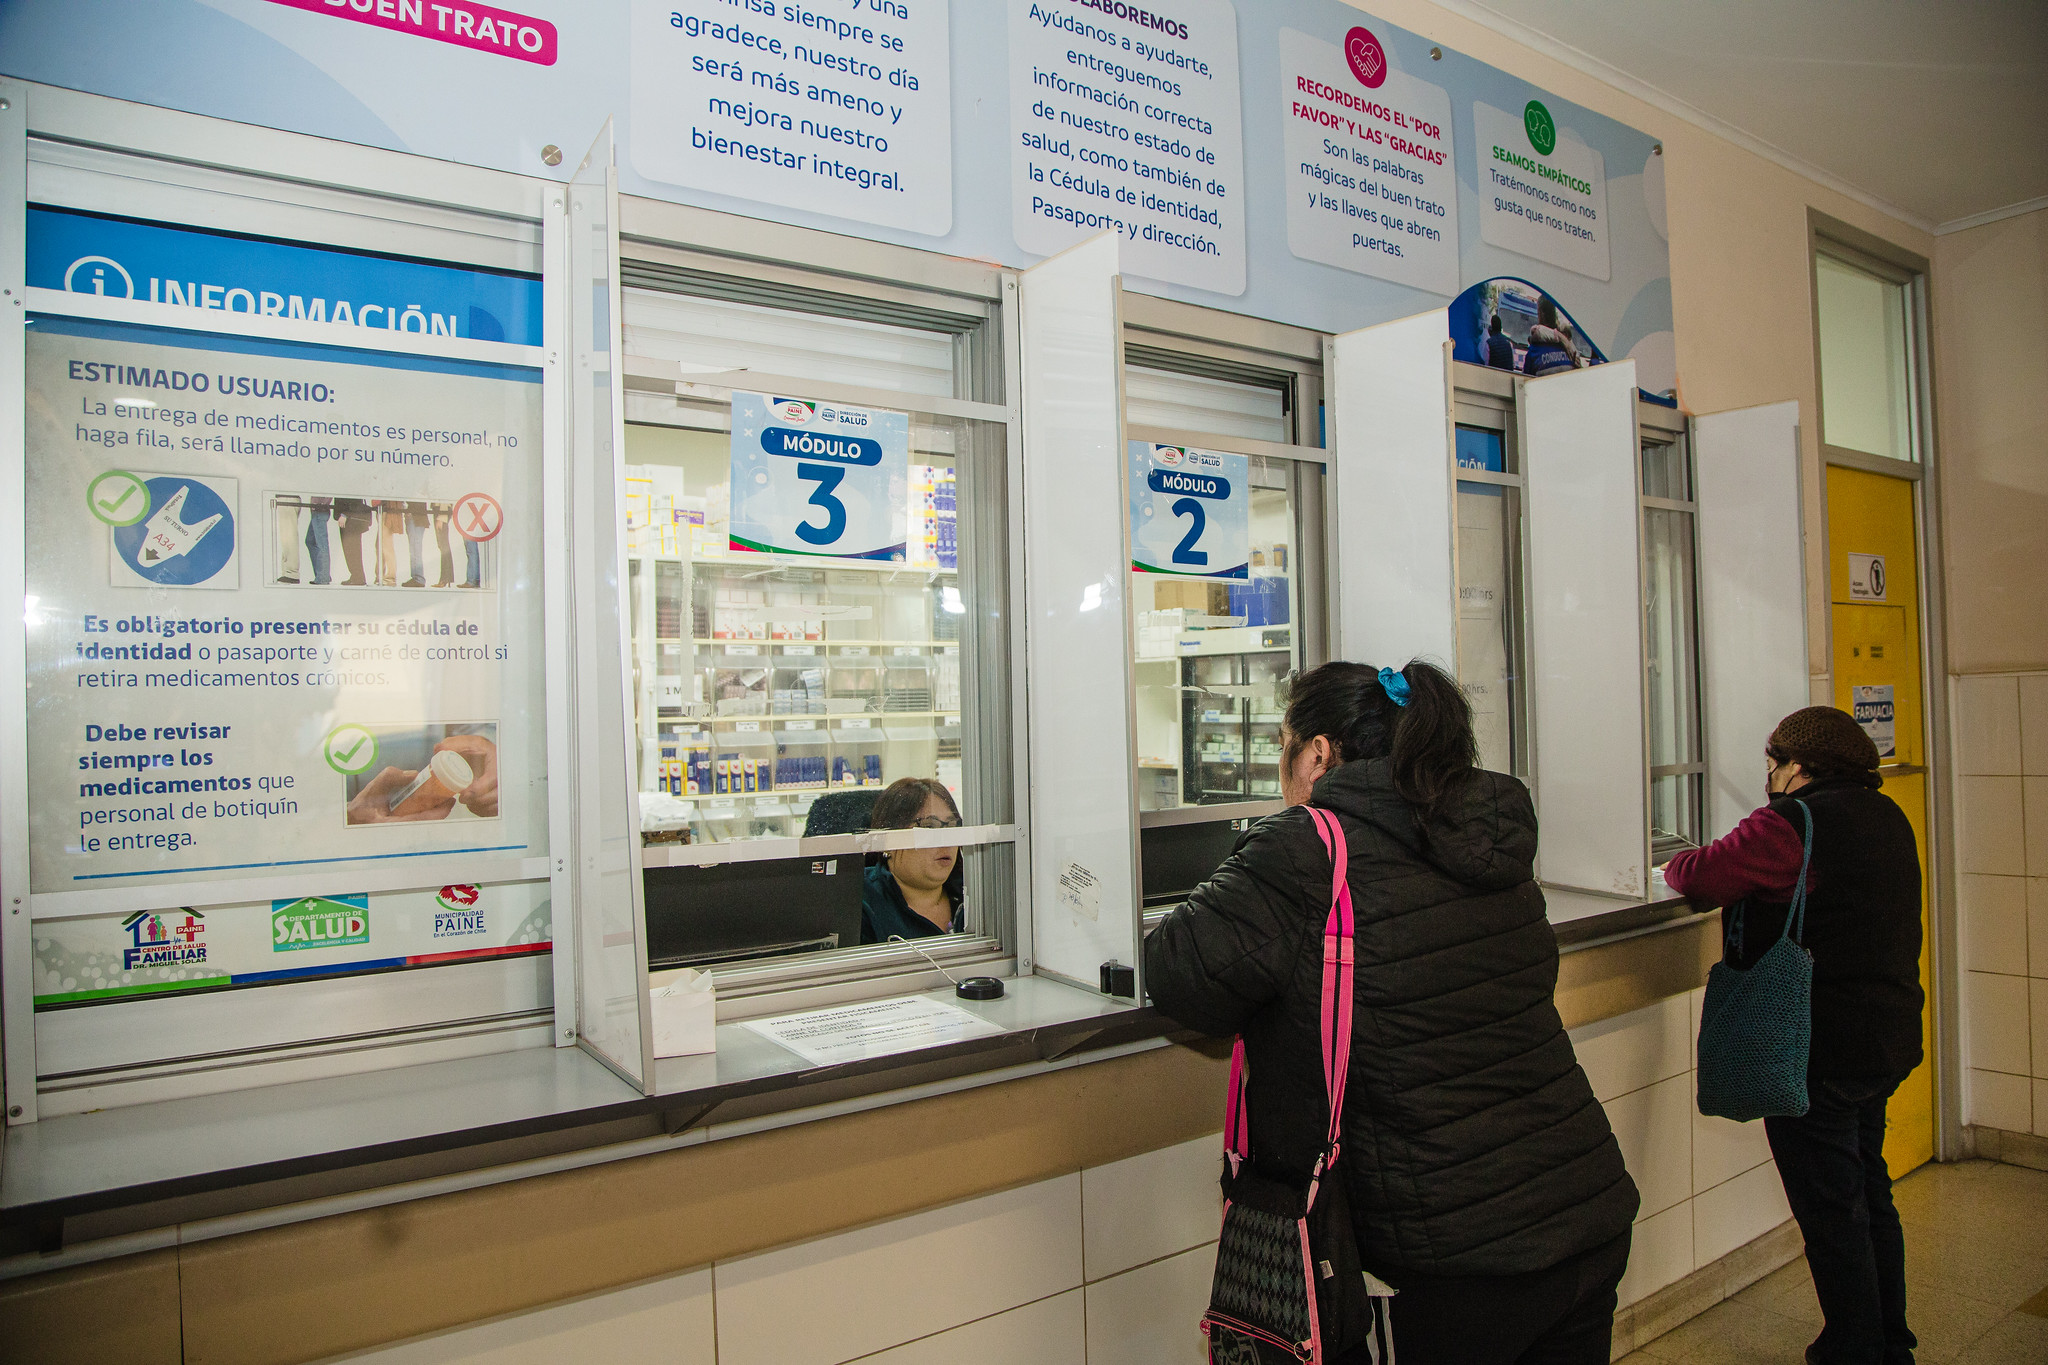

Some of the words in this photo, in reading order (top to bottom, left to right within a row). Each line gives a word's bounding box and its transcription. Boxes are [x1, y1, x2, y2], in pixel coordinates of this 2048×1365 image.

[431, 3, 543, 53] TRATO
[784, 4, 873, 41] siempre
[880, 33, 904, 52] se
[1029, 3, 1117, 47] Ayúdanos
[1121, 37, 1131, 51] a
[1136, 42, 1213, 80] ayudarte,
[670, 11, 787, 60] agradece,
[794, 45, 881, 81] nuestro
[889, 68, 919, 91] día
[1067, 49, 1181, 97] entreguemos
[692, 55, 743, 82] será
[752, 71, 799, 96] más
[807, 84, 884, 117] ameno
[890, 106, 903, 125] y
[1033, 66, 1139, 114] información
[1144, 104, 1213, 135] correcta
[1296, 75, 1391, 122] RECORDEMOS
[1394, 112, 1408, 129] EL
[709, 98, 793, 131] mejora
[801, 119, 888, 153] nuestro
[1032, 100, 1055, 121] de
[1060, 109, 1129, 142] nuestro
[1134, 131, 1191, 158] estado
[1195, 148, 1215, 165] de
[1347, 119, 1356, 135] Y
[1358, 124, 1383, 145] LAS
[692, 127, 806, 171] bienestar
[813, 154, 905, 193] integral.
[1021, 132, 1075, 162] salud,
[1079, 147, 1129, 172] como
[1133, 159, 1201, 191] también
[1206, 179, 1226, 197] de
[1323, 138, 1348, 161] Son
[1352, 147, 1369, 167] las
[1373, 154, 1424, 186] palabras
[1492, 145, 1536, 174] SEAMOS
[1537, 161, 1591, 196] EMPÁTICOS
[1029, 162, 1044, 182] la
[1050, 168, 1110, 199] Cédula
[1115, 186, 1136, 205] de
[1141, 191, 1222, 229] identidad,
[1300, 161, 1355, 190] mágicas
[1359, 175, 1378, 196] del
[1381, 182, 1412, 207] buen
[1415, 192, 1445, 218] trato
[1490, 168, 1549, 204] Tratémonos
[1551, 190, 1577, 212] como
[1579, 202, 1596, 221] nos
[1033, 196, 1123, 234] Pasaporte
[1128, 222, 1138, 240] y
[1142, 224, 1221, 257] dirección.
[1308, 193, 1317, 208] y
[1320, 193, 1338, 212] las
[1341, 198, 1378, 223] llaves
[1380, 215, 1404, 234] que
[1406, 218, 1441, 243] abren
[1494, 197, 1522, 222] gusta
[1525, 205, 1543, 226] que
[1545, 213, 1562, 231] nos
[1564, 218, 1596, 243] traten.
[1352, 232, 1404, 259] puertas.
[150, 278, 457, 338] INFORMACIÓN
[68, 360, 209, 395] ESTIMADO
[217, 375, 336, 404] USUARIO:
[82, 397, 107, 417] La
[114, 400, 197, 428] entrega
[203, 407, 229, 428] de
[235, 412, 381, 440] medicamentos
[386, 426, 406, 440] es
[412, 423, 492, 449] personal,
[497, 433, 518, 448] no
[840, 416, 868, 426] SALUD
[76, 424, 129, 448] haga
[135, 426, 175, 449] fila,
[181, 431, 224, 453] será
[230, 436, 311, 459] llamado
[317, 445, 349, 463] por
[354, 448, 375, 464] su
[381, 447, 455, 467] número.
[783, 432, 862, 459] MÓDULO
[795, 462, 848, 545] 3
[1163, 473, 1217, 494] MÓDULO
[153, 533, 176, 551] A34
[164, 516, 173, 524] SU
[171, 520, 189, 537] TURNO
[1172, 497, 1208, 566] 2
[84, 615, 109, 633] Es
[116, 616, 244, 637] obligatorio
[250, 619, 352, 638] presentar
[357, 622, 380, 636] su
[385, 618, 451, 636] cédula
[456, 619, 479, 636] de
[76, 642, 192, 661] identidad
[198, 647, 211, 661] o
[217, 644, 318, 665] pasaporte
[323, 647, 334, 664] y
[340, 643, 392, 661] carné
[398, 643, 420, 661] de
[426, 643, 490, 661] control
[495, 644, 509, 660] si
[77, 669, 138, 688] retira
[145, 669, 300, 688] medicamentos
[306, 668, 390, 687] crónicos.
[85, 723, 147, 742] Debe
[153, 723, 231, 741] revisar
[1855, 704, 1893, 720] FARMACIA
[78, 750, 175, 772] siempre
[181, 748, 214, 767] los
[80, 774, 252, 797] medicamentos
[258, 775, 295, 793] que
[80, 803, 173, 829] personal
[181, 800, 208, 821] de
[213, 796, 298, 821] botiquín
[80, 834, 101, 852] le
[107, 829, 198, 853] entrega.
[274, 914, 366, 944] SALUD
[289, 911, 351, 922] DEPARTAMENTO
[435, 910, 484, 919] MUNICIPALIDAD
[435, 915, 485, 932] PAINE
[124, 948, 207, 970] FAMILIAR
[142, 945, 171, 953] CENTRO
[184, 942, 206, 950] SALUD
[149, 960, 179, 968] MIGUEL
